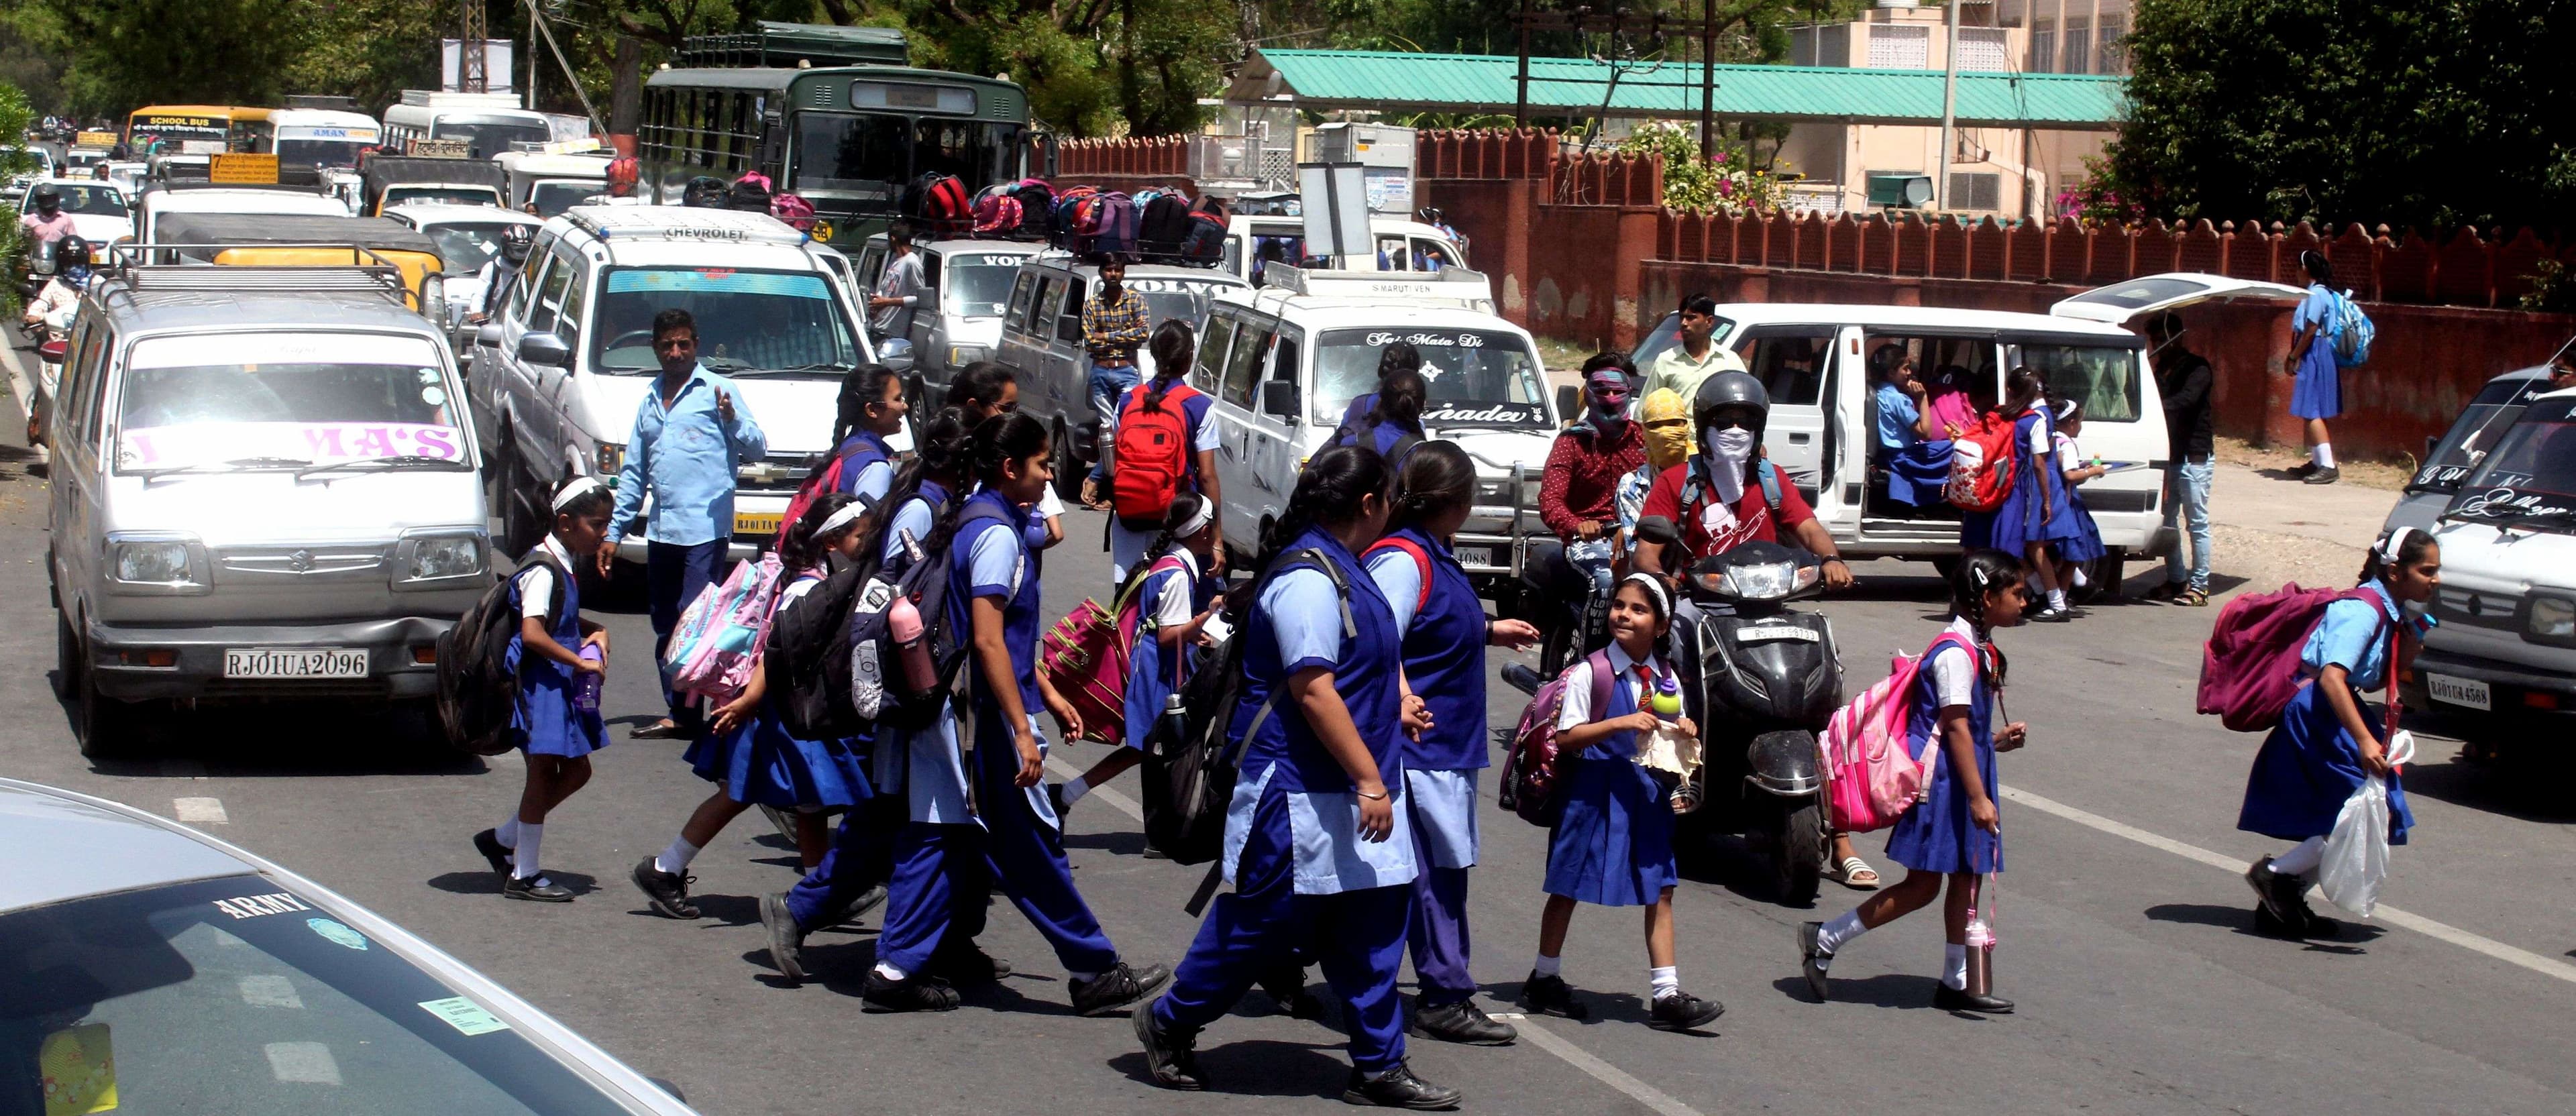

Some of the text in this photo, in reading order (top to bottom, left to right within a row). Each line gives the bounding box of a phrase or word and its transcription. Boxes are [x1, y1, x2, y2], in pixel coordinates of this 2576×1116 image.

[150, 117, 188, 125] SCHOOL
[313, 129, 346, 137] AMAN
[409, 140, 417, 154] 7
[213, 154, 221, 168] 7
[667, 228, 745, 240] CHEVROLET
[983, 256, 1022, 266] VOL
[1406, 333, 1455, 347] Mata
[1458, 333, 1484, 348] Di
[738, 520, 749, 529] RJ
[761, 520, 772, 530] TA
[1755, 617, 1788, 625] HONDA
[227, 654, 365, 675] RJ01UA2096
[212, 892, 312, 919] ARMY
